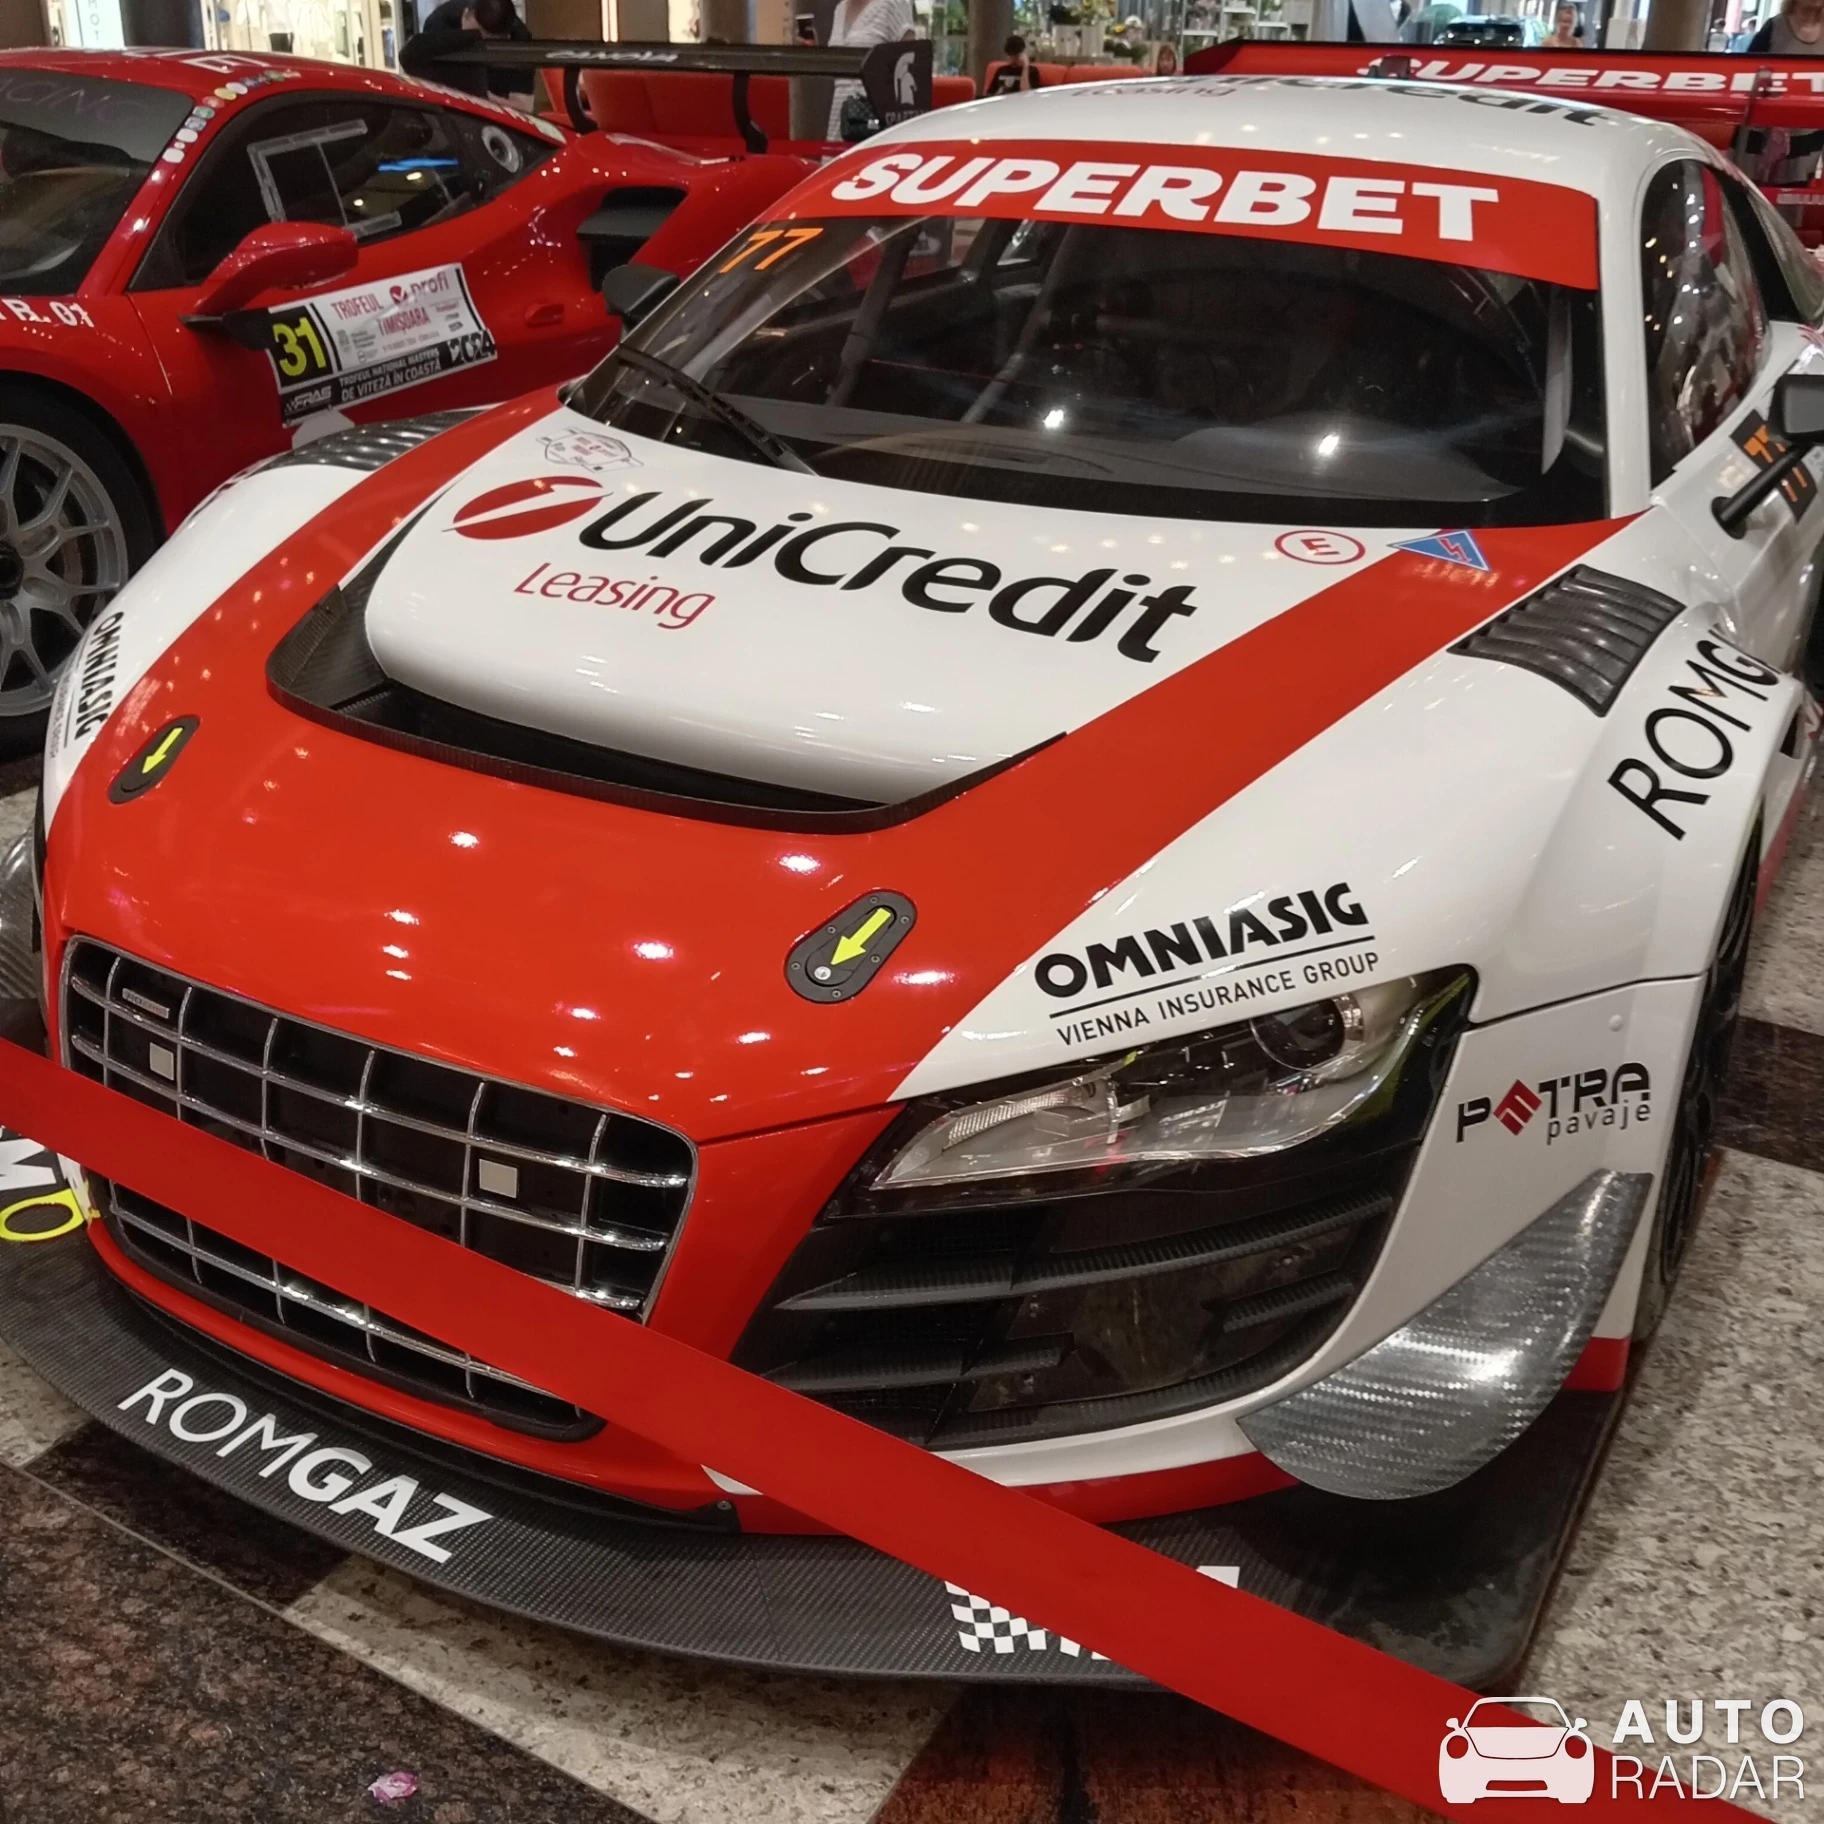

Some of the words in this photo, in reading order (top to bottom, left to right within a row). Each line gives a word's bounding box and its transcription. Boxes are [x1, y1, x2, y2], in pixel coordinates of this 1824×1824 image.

[831, 153, 1499, 241] SUPERBET
[720, 228, 823, 273] 77
[331, 293, 384, 320] TROFEUL
[273, 317, 327, 377] 31
[340, 369, 371, 387] TROFEUL
[371, 359, 408, 377] NATIONAL
[448, 330, 495, 364] 2024
[341, 385, 355, 401] DE
[514, 562, 716, 630] Leasing
[578, 491, 1198, 664] UniCredit
[75, 611, 124, 741] OMNIASIG
[1034, 882, 1370, 998] OMNIASIG
[1057, 1006, 1151, 1046] VIENNA
[1157, 969, 1297, 1021] INSURANCE
[1303, 951, 1380, 985] GROUP
[1546, 1101, 1651, 1145] pavaje
[117, 1367, 495, 1564] ROMGAZ
